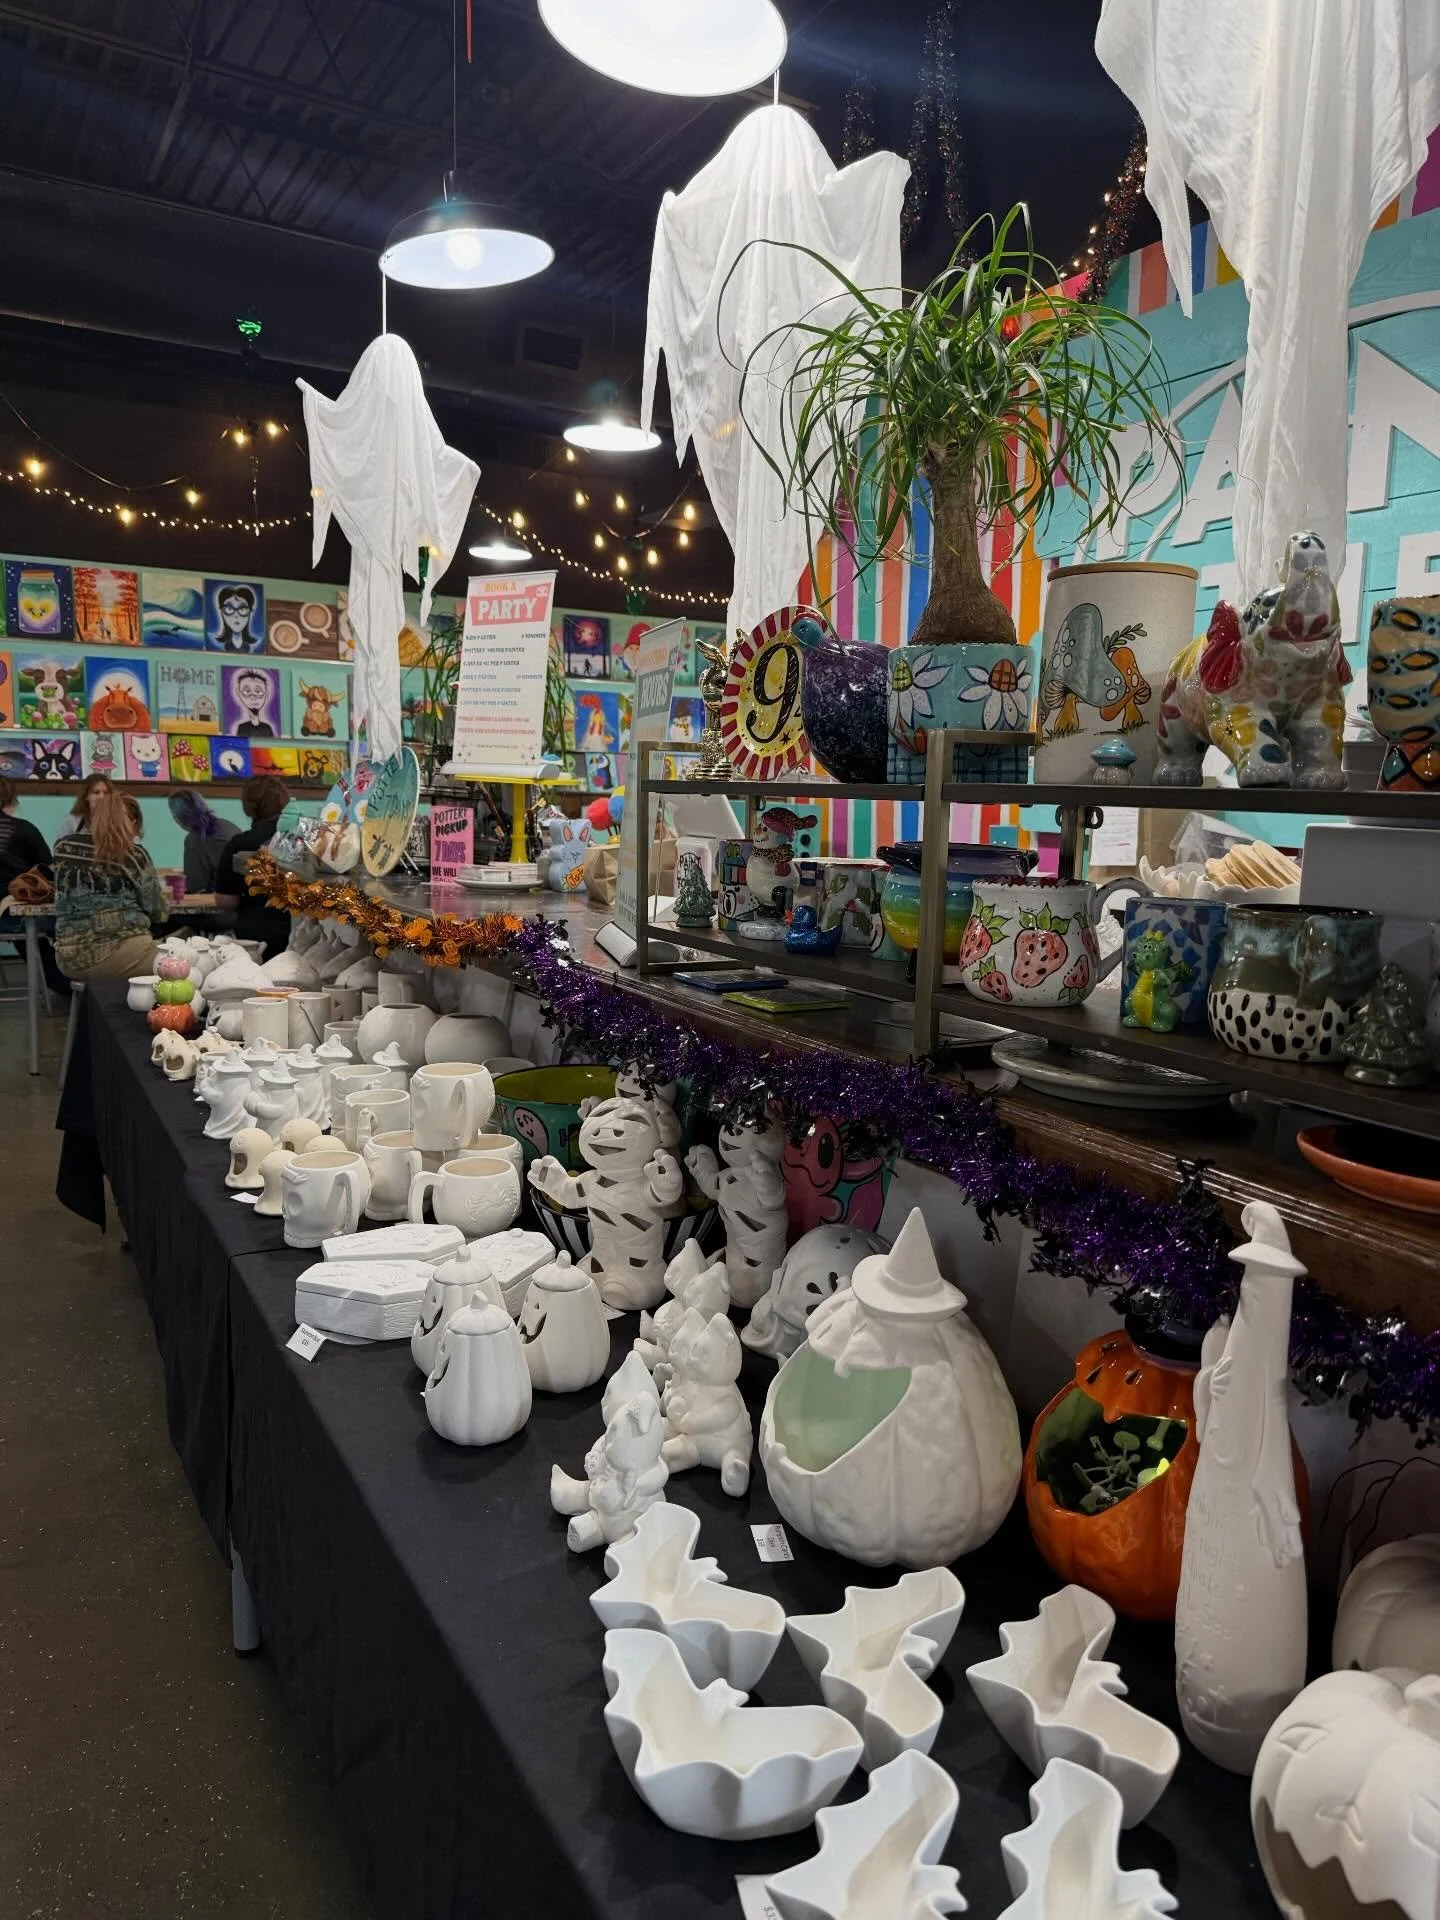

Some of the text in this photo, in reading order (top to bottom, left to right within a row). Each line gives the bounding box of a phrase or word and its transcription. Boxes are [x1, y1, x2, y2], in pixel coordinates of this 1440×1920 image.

[478, 598, 538, 620] PARTY
[641, 671, 670, 709] HOURS
[434, 807, 467, 825] POTTERY
[435, 818, 468, 838] PICKUP
[432, 867, 457, 877] WE WILL
